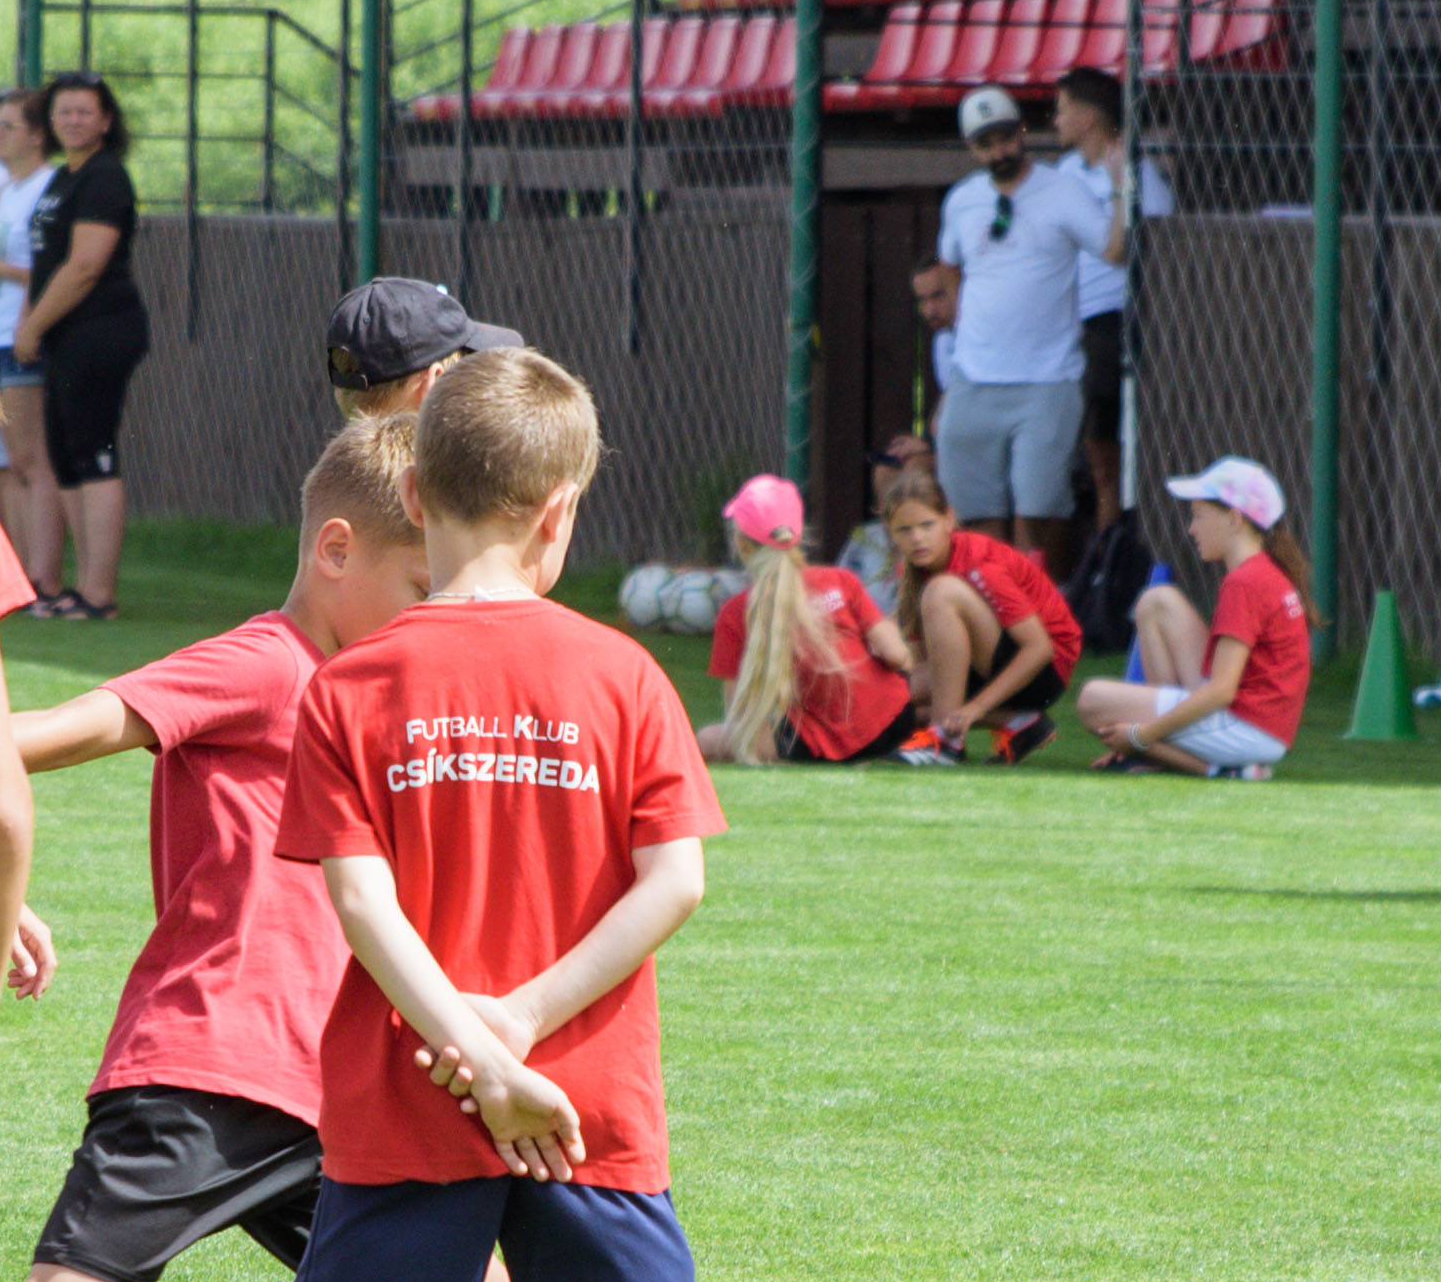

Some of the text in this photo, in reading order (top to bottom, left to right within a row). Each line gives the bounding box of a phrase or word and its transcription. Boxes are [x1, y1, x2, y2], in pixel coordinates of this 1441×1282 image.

[406, 715, 580, 744] FUTBALL KLUB
[386, 747, 600, 794] CSÍKSZEREDA
